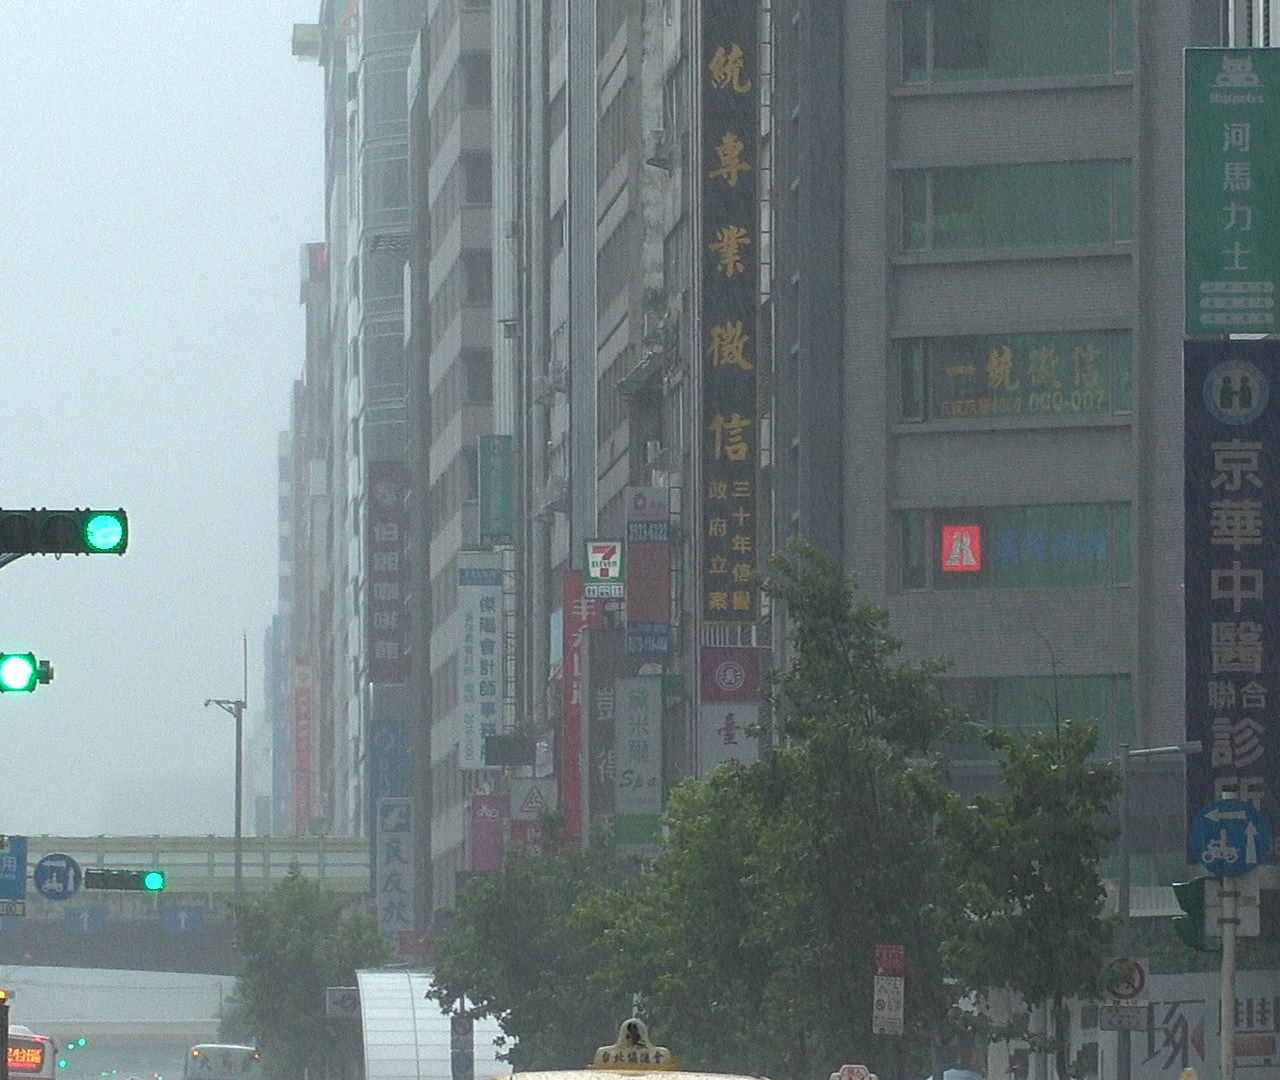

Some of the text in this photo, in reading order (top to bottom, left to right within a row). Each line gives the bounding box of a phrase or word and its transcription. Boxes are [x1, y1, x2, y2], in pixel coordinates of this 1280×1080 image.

[1223, 123, 1253, 271] 河馬力士
[620, 769, 656, 790] Spa
